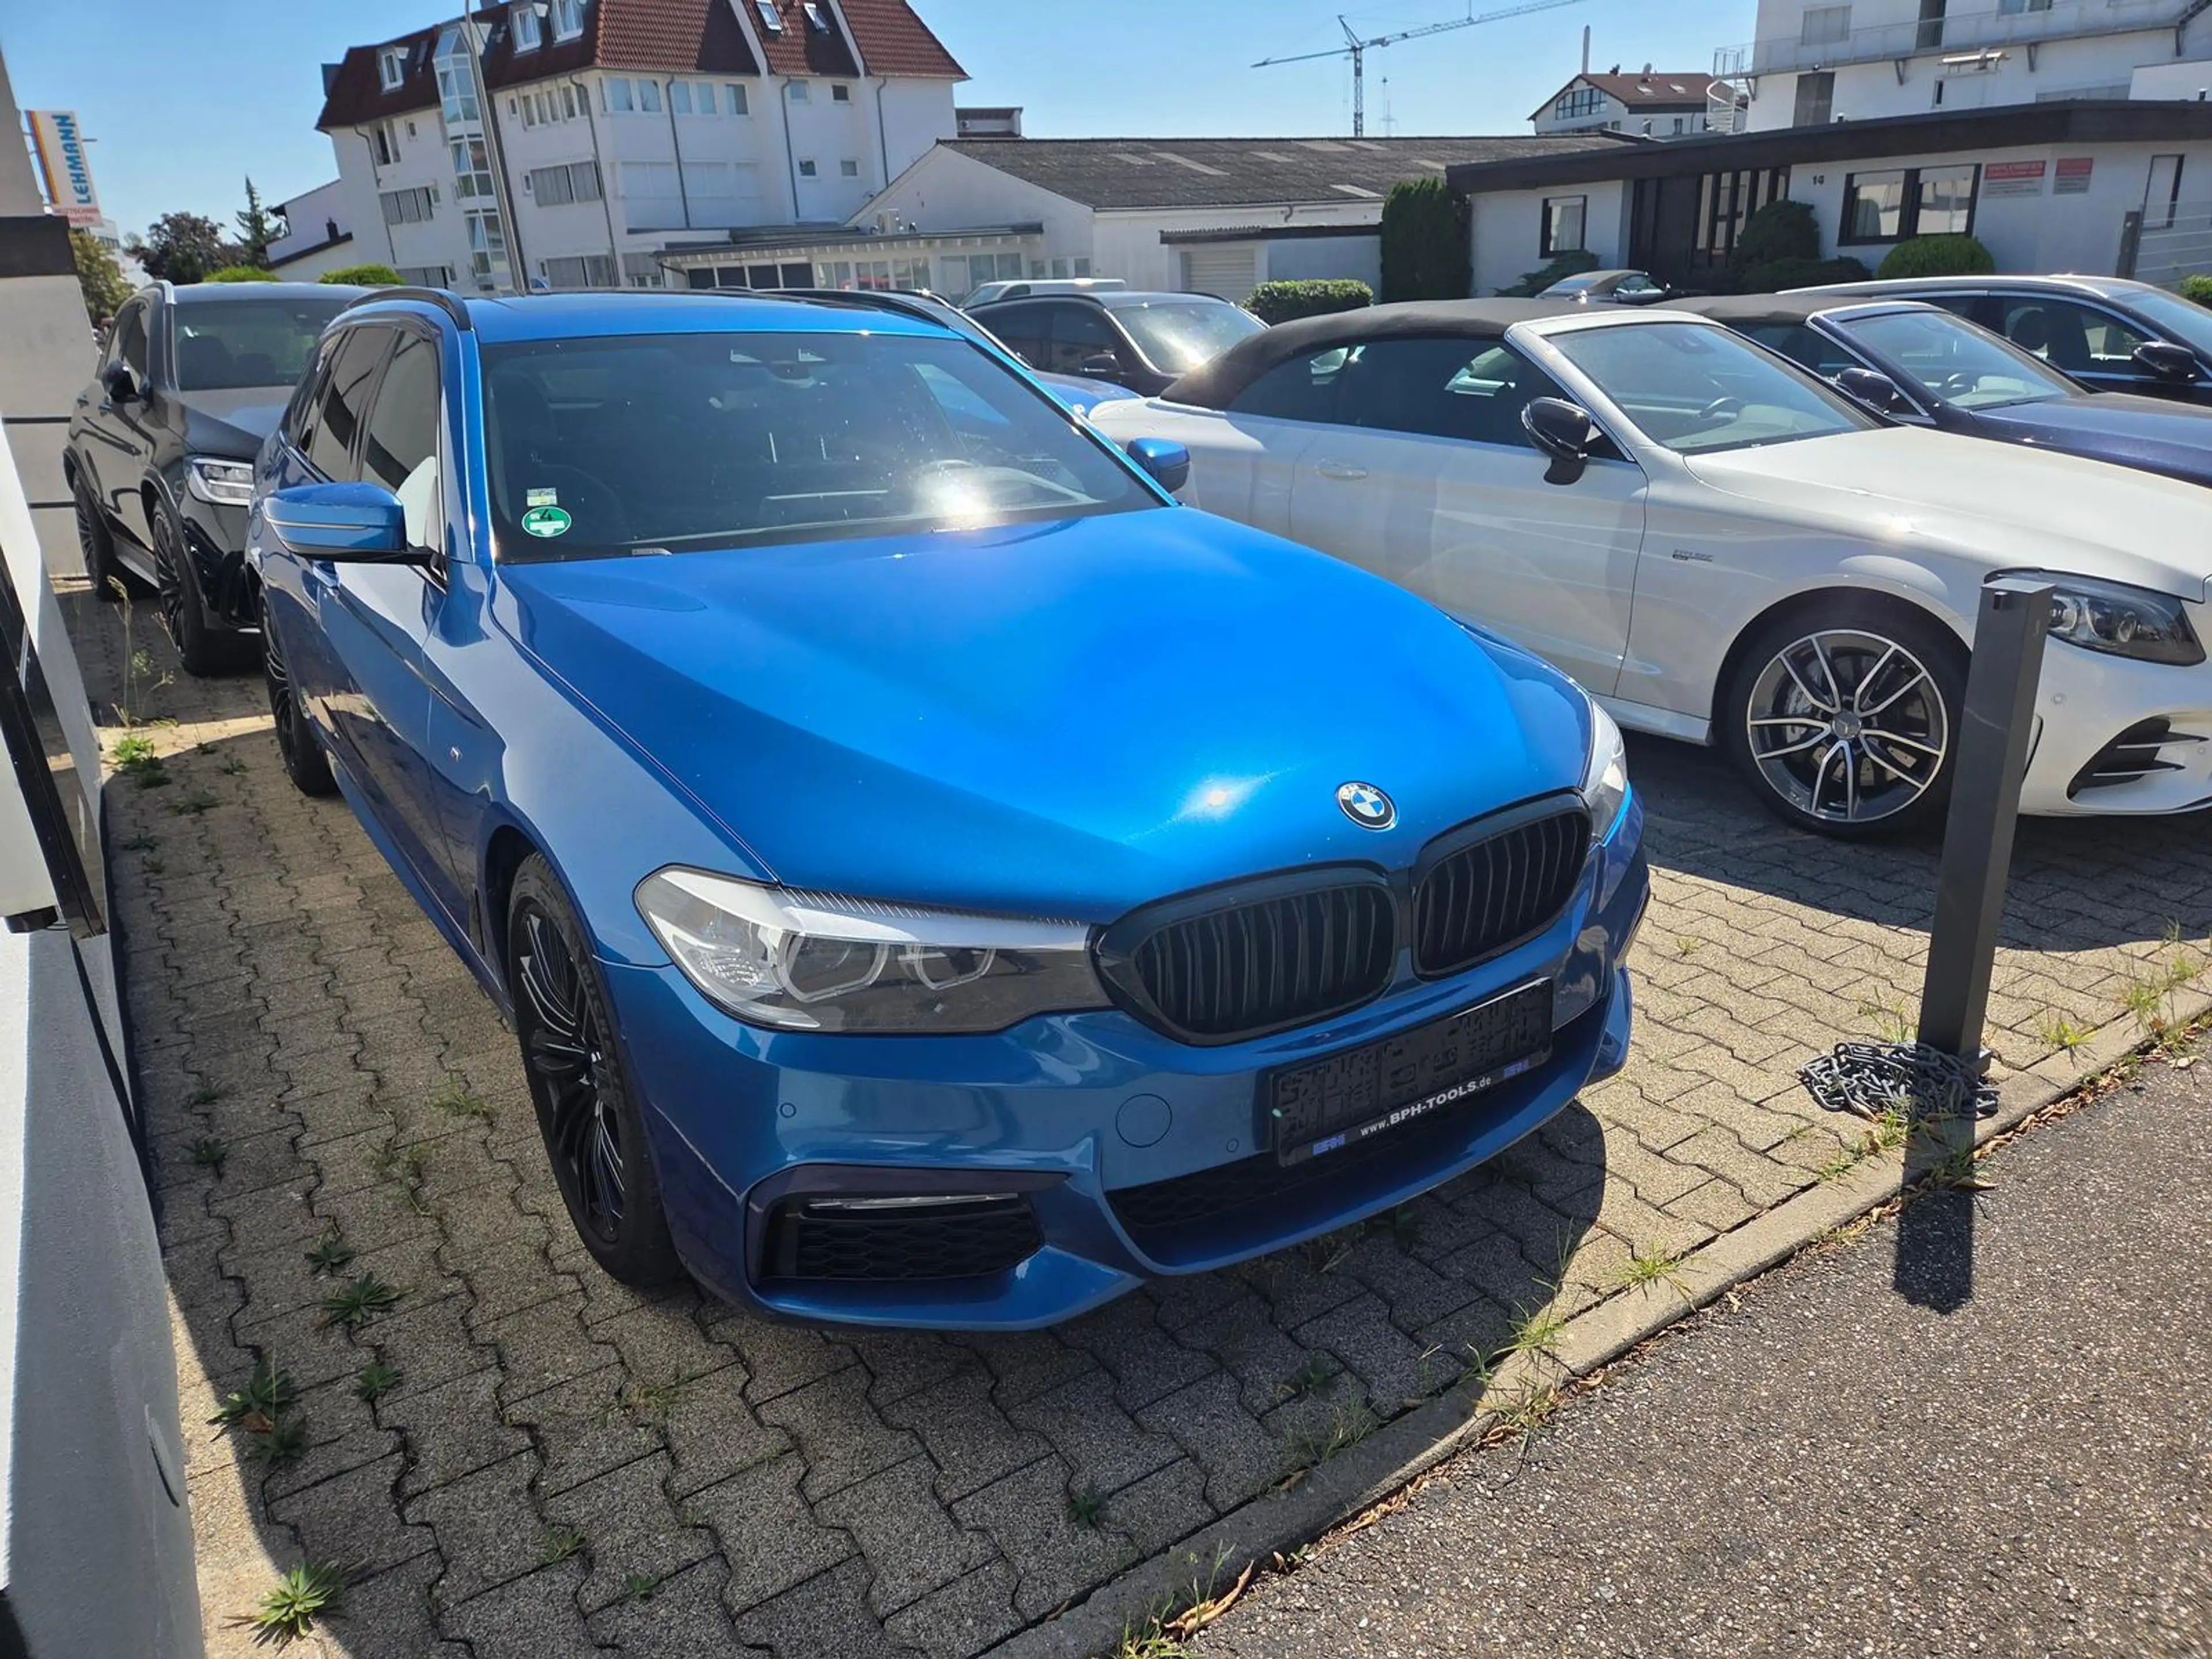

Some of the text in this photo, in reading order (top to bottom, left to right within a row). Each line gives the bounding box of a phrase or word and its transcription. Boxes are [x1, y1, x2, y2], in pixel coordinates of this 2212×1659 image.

[51, 114, 92, 204] LEHMANN
[540, 509, 554, 521] 4
[1360, 1075, 1491, 1137] www.BPH-TOOLS.de
